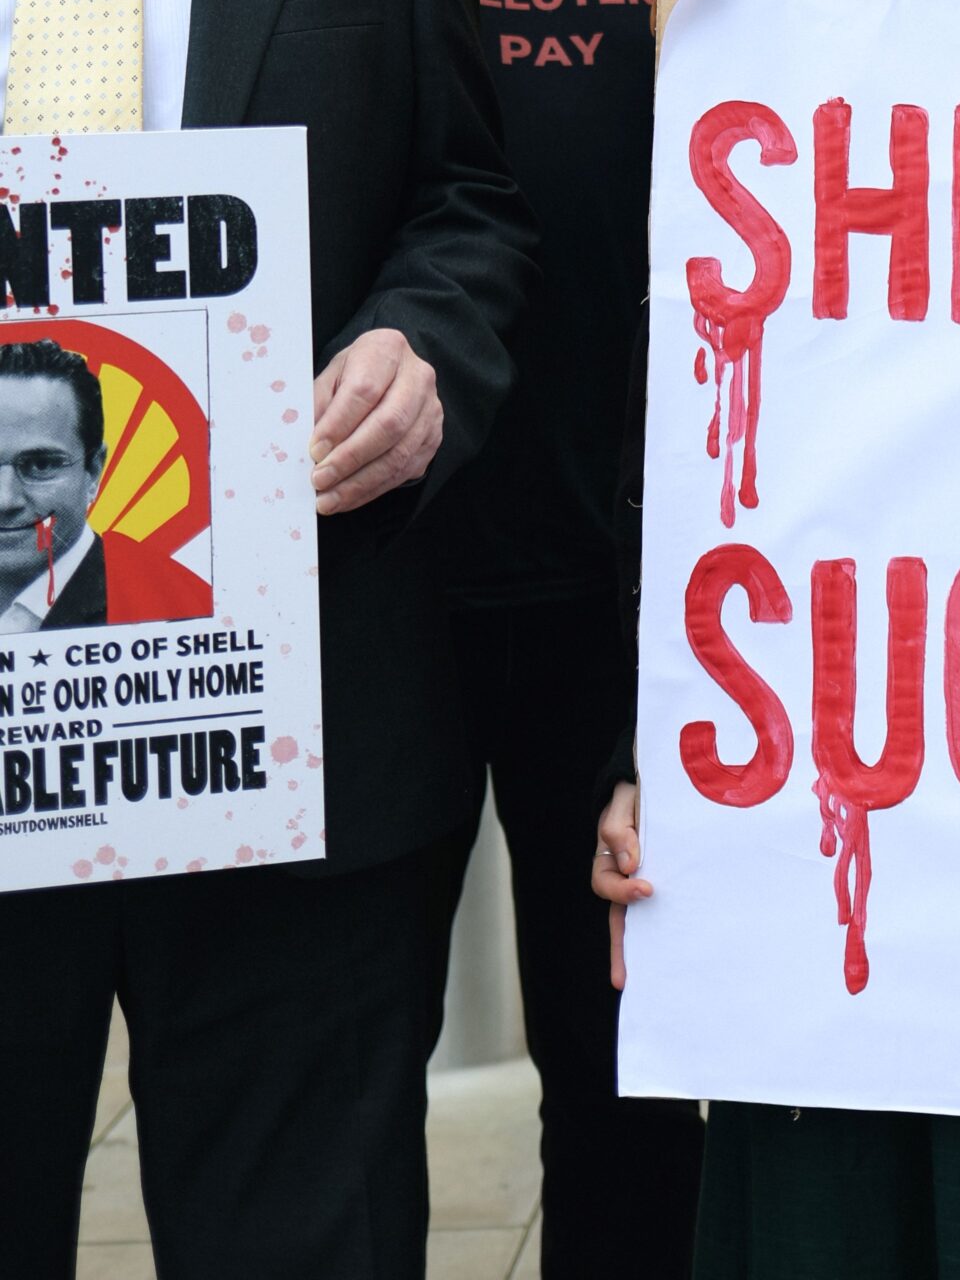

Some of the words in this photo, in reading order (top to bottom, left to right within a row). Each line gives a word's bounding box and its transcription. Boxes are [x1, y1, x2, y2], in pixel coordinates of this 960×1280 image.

[500, 32, 604, 67] PAY
[65, 641, 122, 667] CEO
[131, 637, 168, 661] OF
[176, 629, 263, 657] SHELL
[21, 681, 46, 706] OF
[53, 675, 108, 712] OUR
[114, 668, 182, 707] ONLY
[189, 660, 264, 699] HOME
[0, 743, 87, 817] BLE
[93, 725, 267, 806] FUTURE
